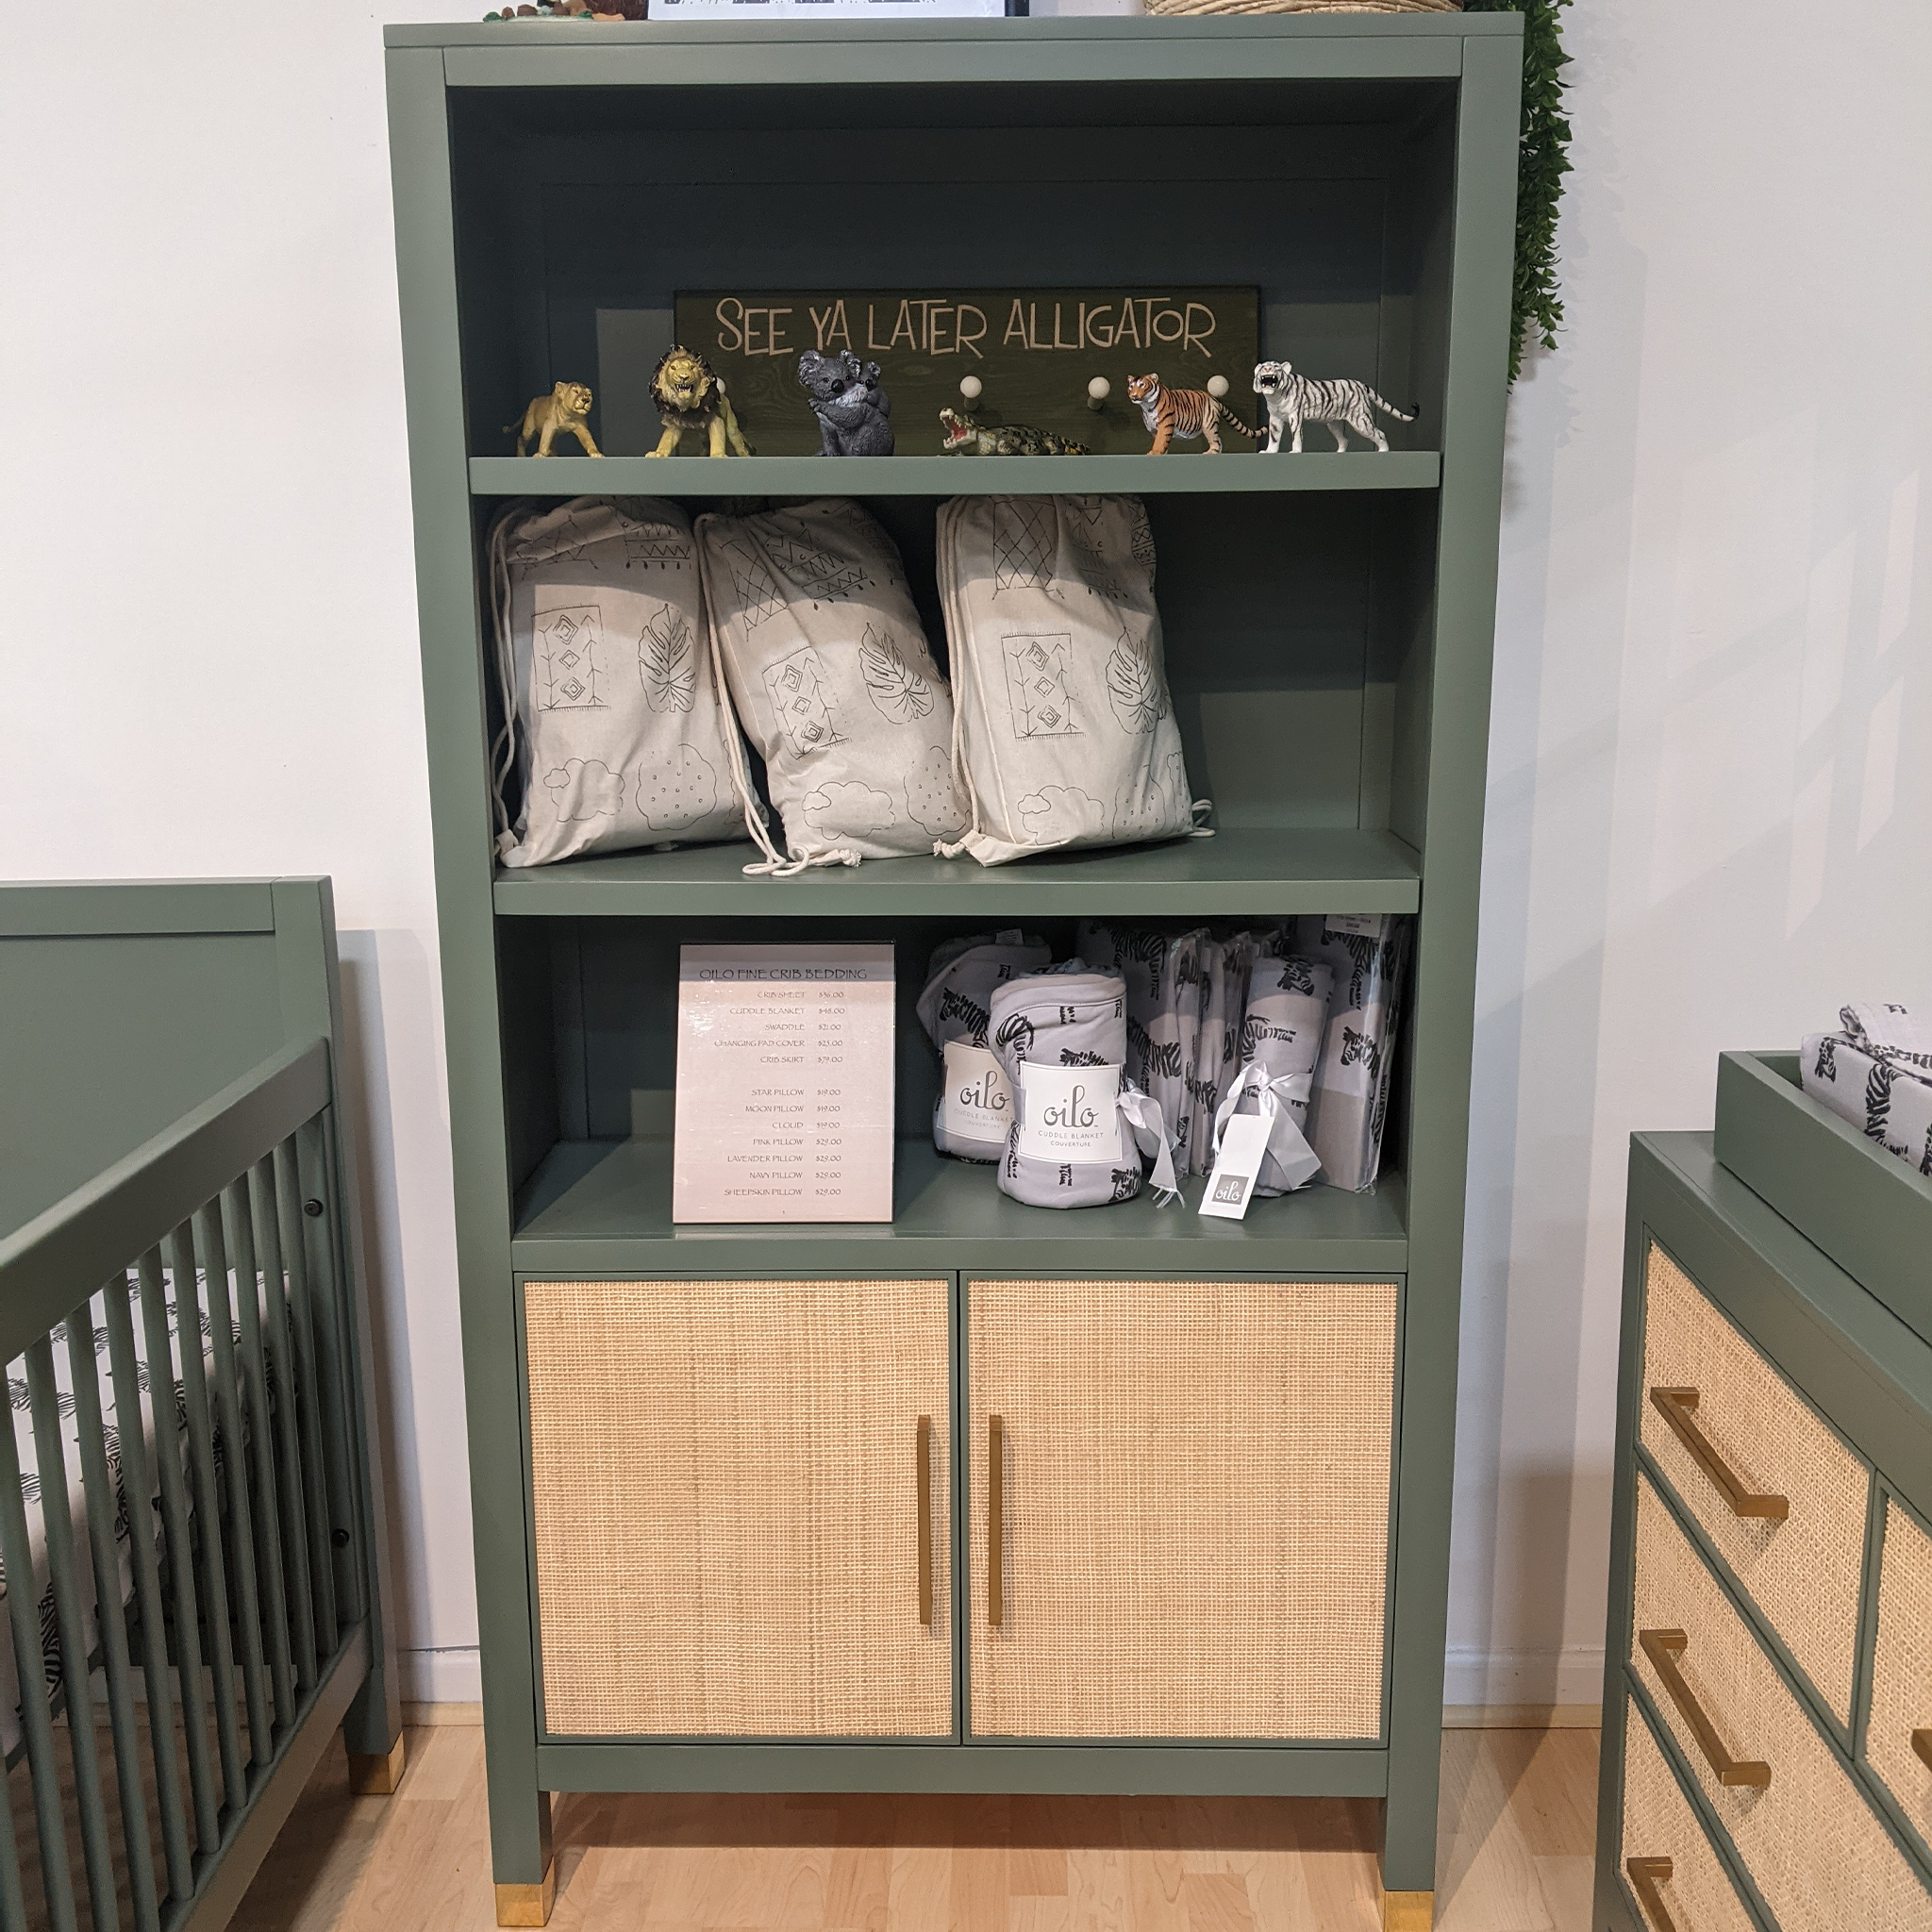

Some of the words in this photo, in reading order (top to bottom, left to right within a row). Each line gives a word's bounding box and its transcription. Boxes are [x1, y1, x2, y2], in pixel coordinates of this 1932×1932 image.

[715, 297, 794, 356] SEE
[808, 299, 852, 351] YA
[868, 299, 988, 359] LATER
[1003, 297, 1216, 358] ALLIGATOR
[699, 968, 734, 979] OILO
[738, 968, 767, 979] FINE
[770, 968, 802, 979] CRIB
[805, 968, 867, 979] BEDDING
[817, 1056, 843, 1065] $79.00
[817, 1089, 841, 1097] $19.00
[960, 1070, 1009, 1110] oilo
[1043, 1085, 1099, 1128] oilo
[816, 1122, 841, 1130] $19.00
[1038, 1130, 1068, 1139] CUDDLE
[816, 1139, 842, 1147] $29.00
[815, 1155, 841, 1163] $29.00
[815, 1172, 841, 1180] $29.00
[815, 1189, 841, 1197] $29.00
[1215, 1180, 1241, 1201] oilo
